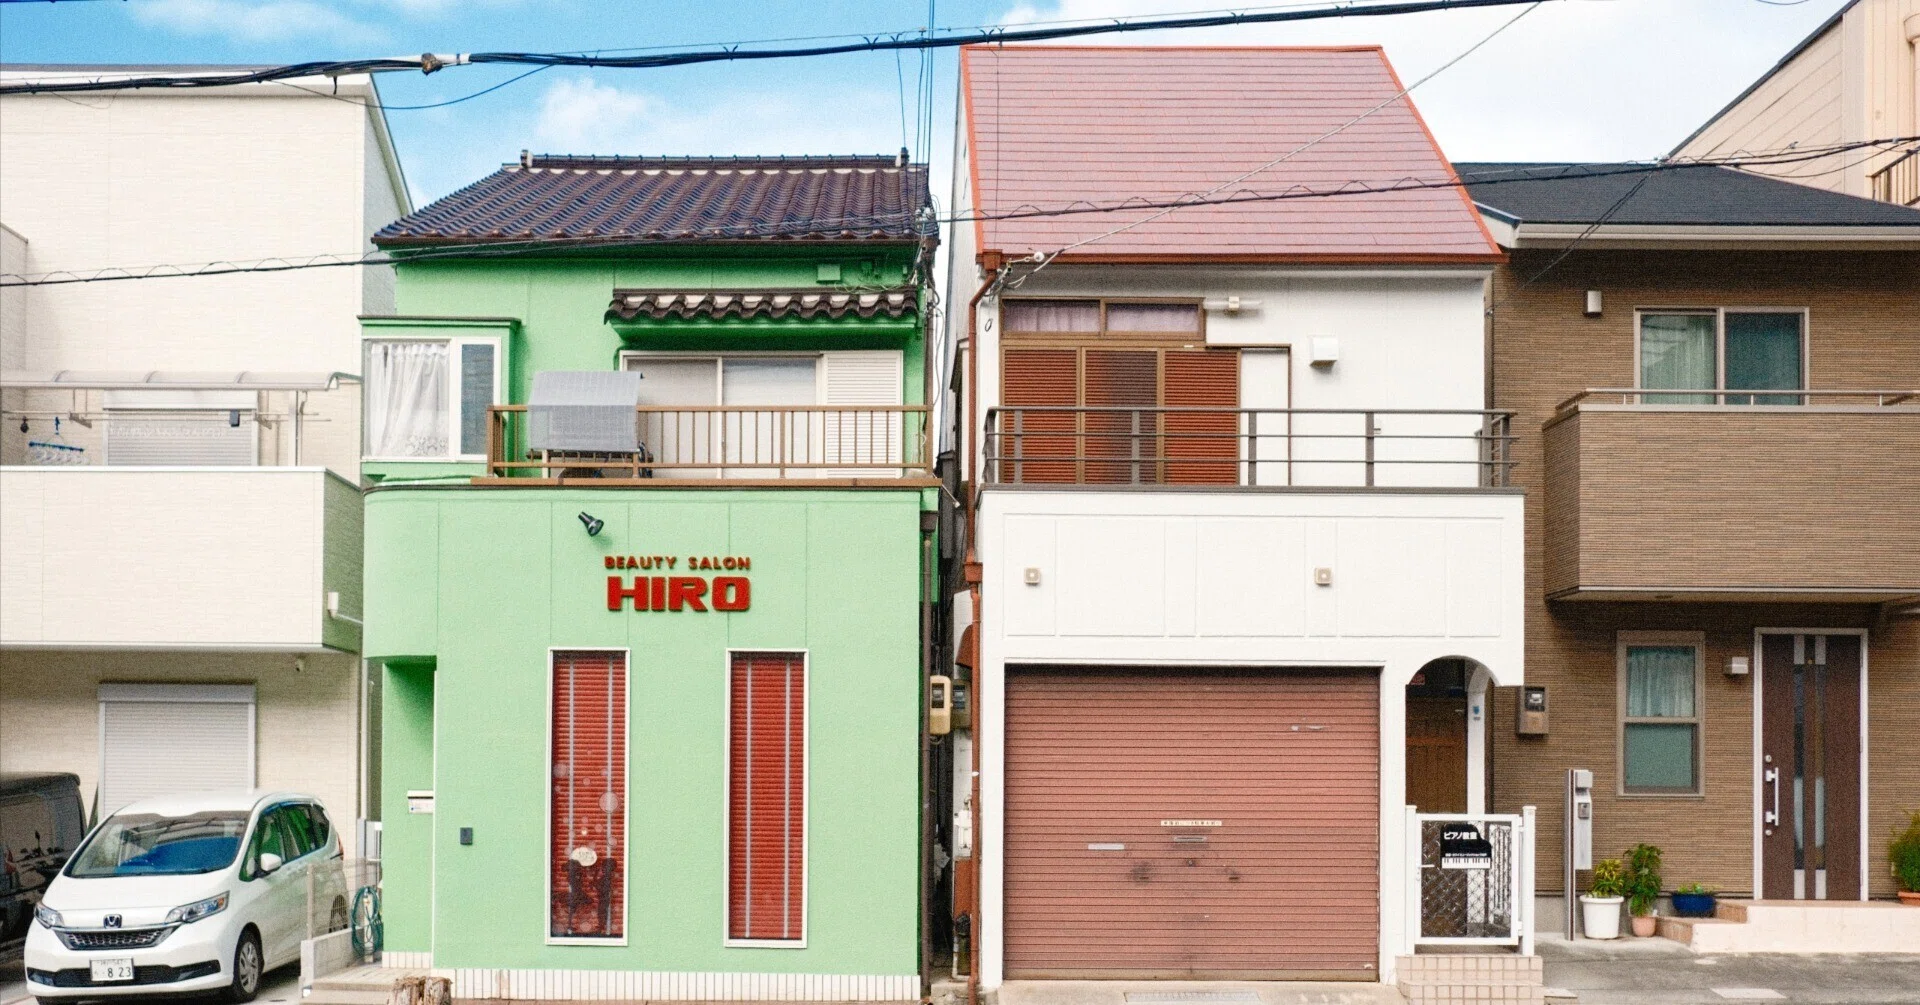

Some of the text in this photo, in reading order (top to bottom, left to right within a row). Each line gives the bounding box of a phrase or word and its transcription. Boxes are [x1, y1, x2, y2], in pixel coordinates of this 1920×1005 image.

[604, 556, 751, 570] BEAUTY SALON
[607, 576, 751, 612] HIRO
